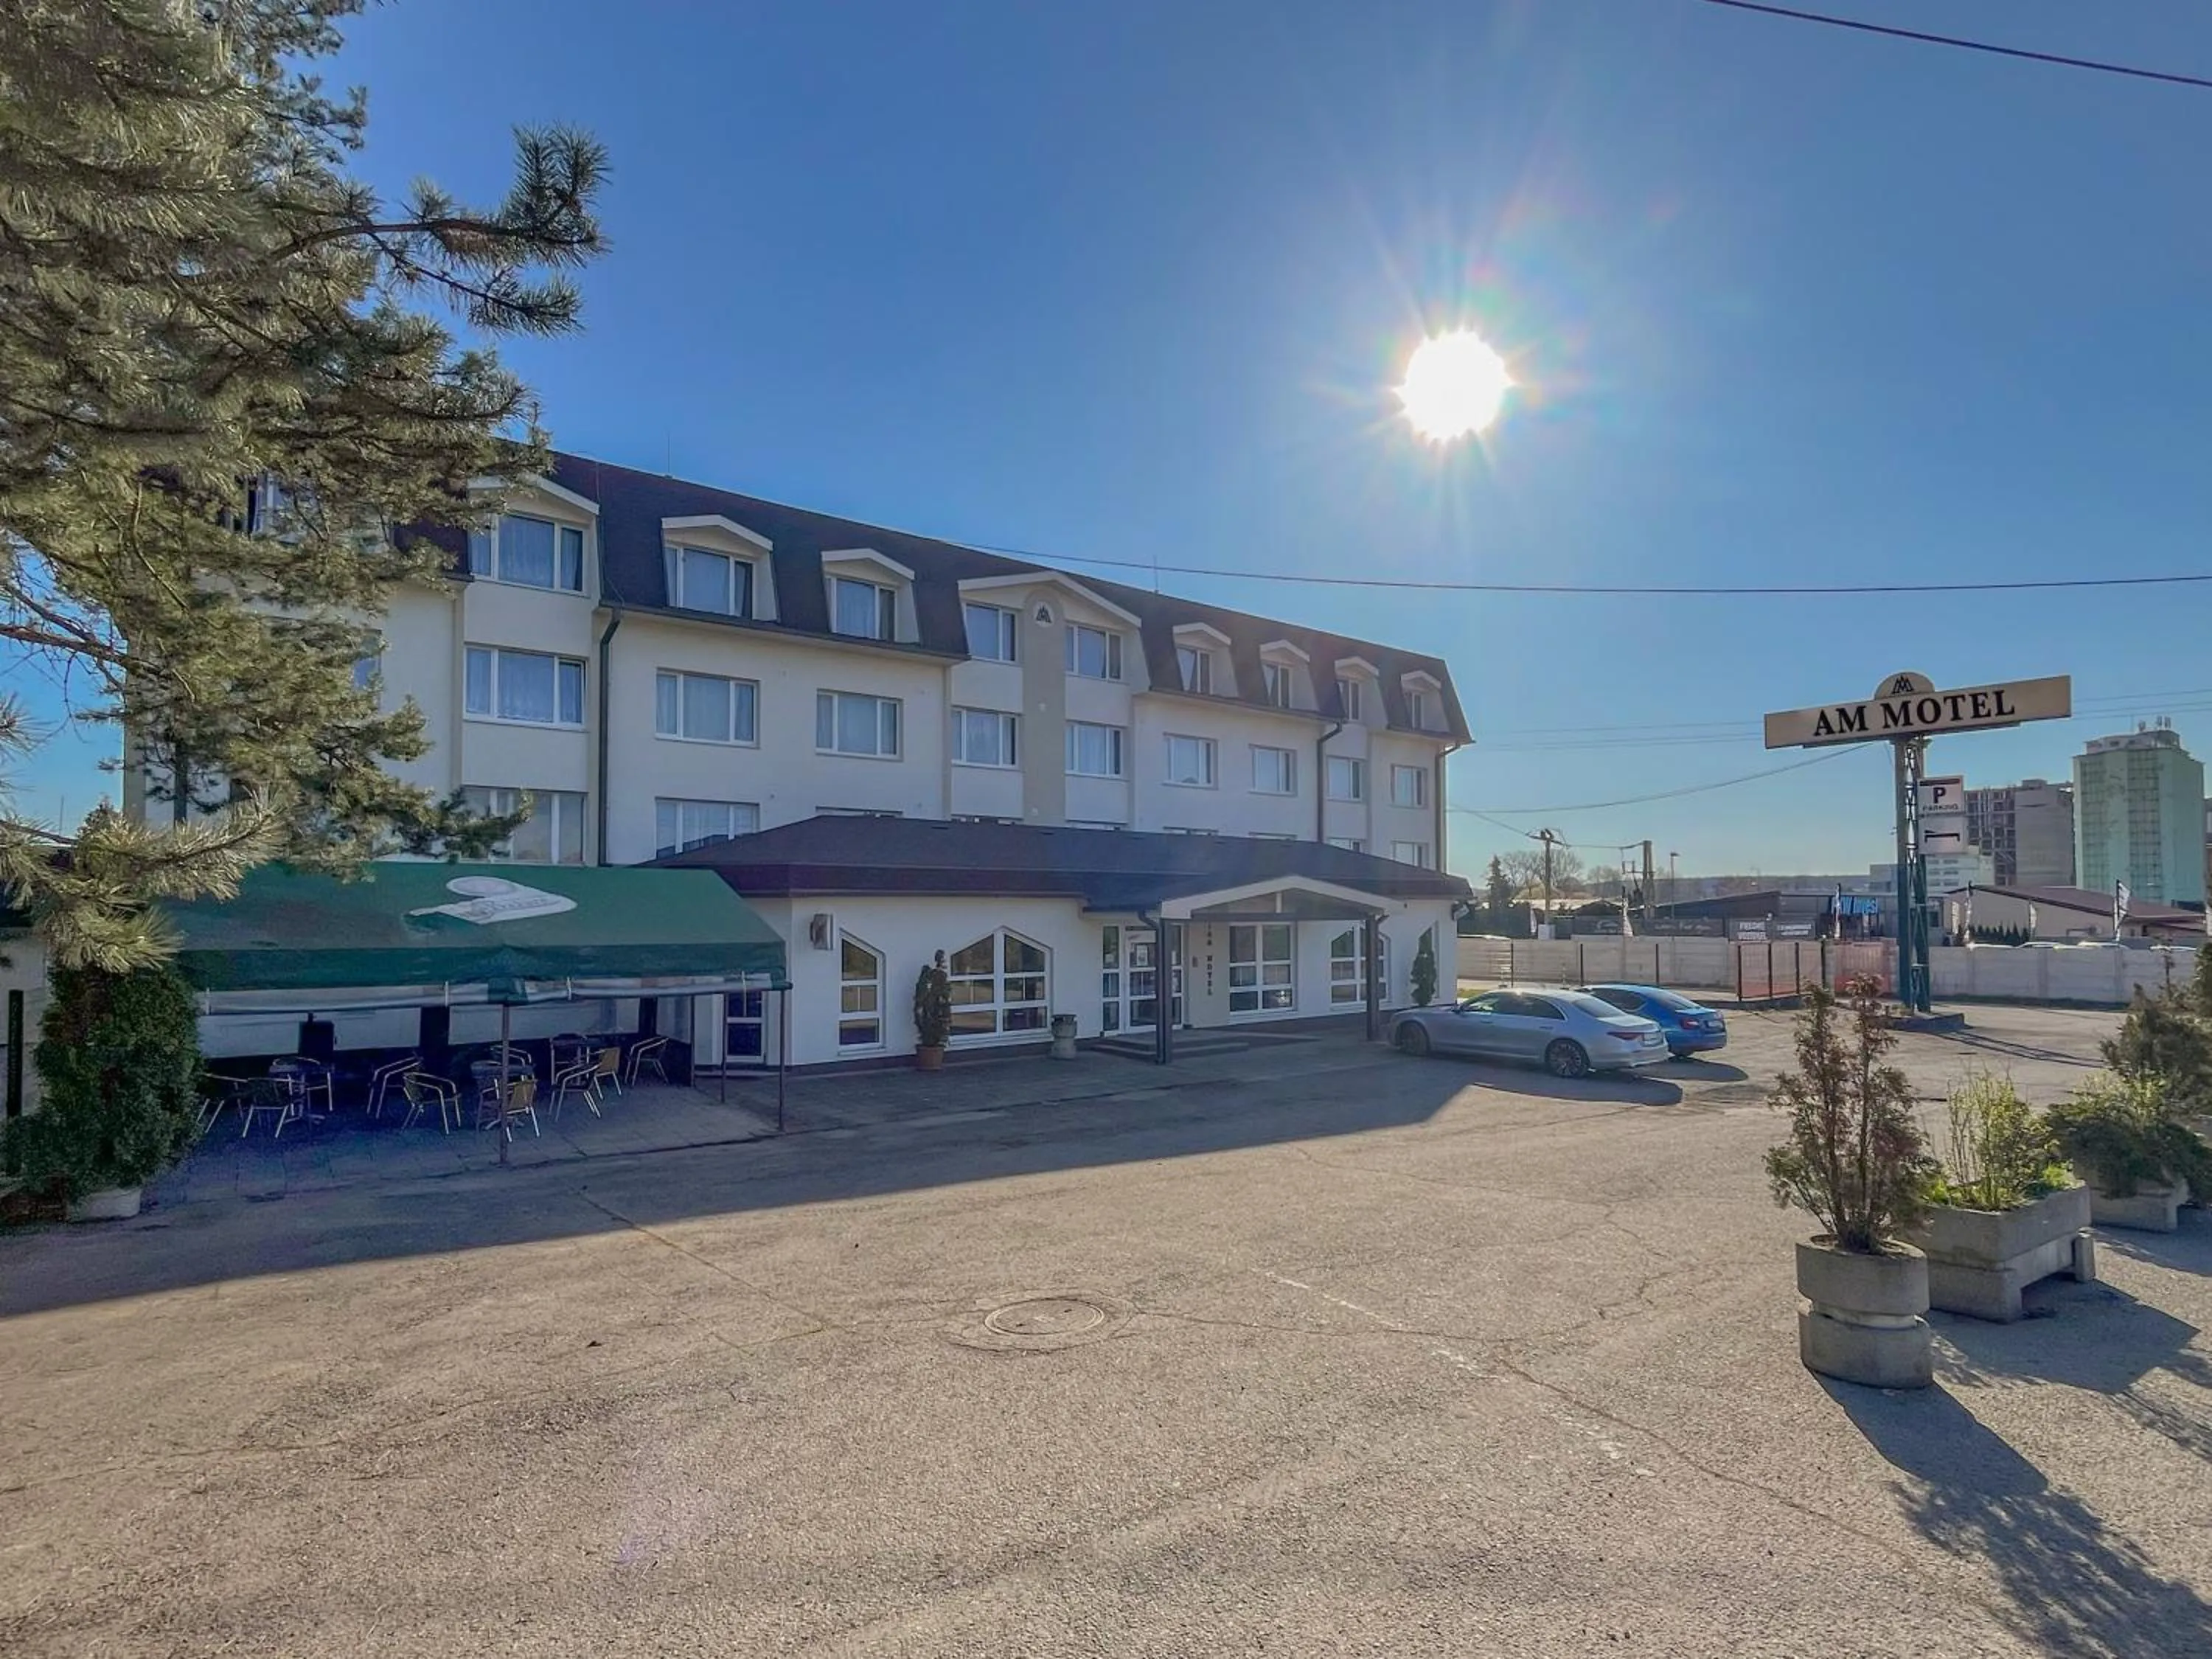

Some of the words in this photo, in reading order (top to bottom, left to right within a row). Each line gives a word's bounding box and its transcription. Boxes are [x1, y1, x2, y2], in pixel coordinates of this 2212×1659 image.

[1813, 706, 1869, 737] AM
[1880, 689, 2015, 729] MOTEL
[1933, 787, 1947, 804] P
